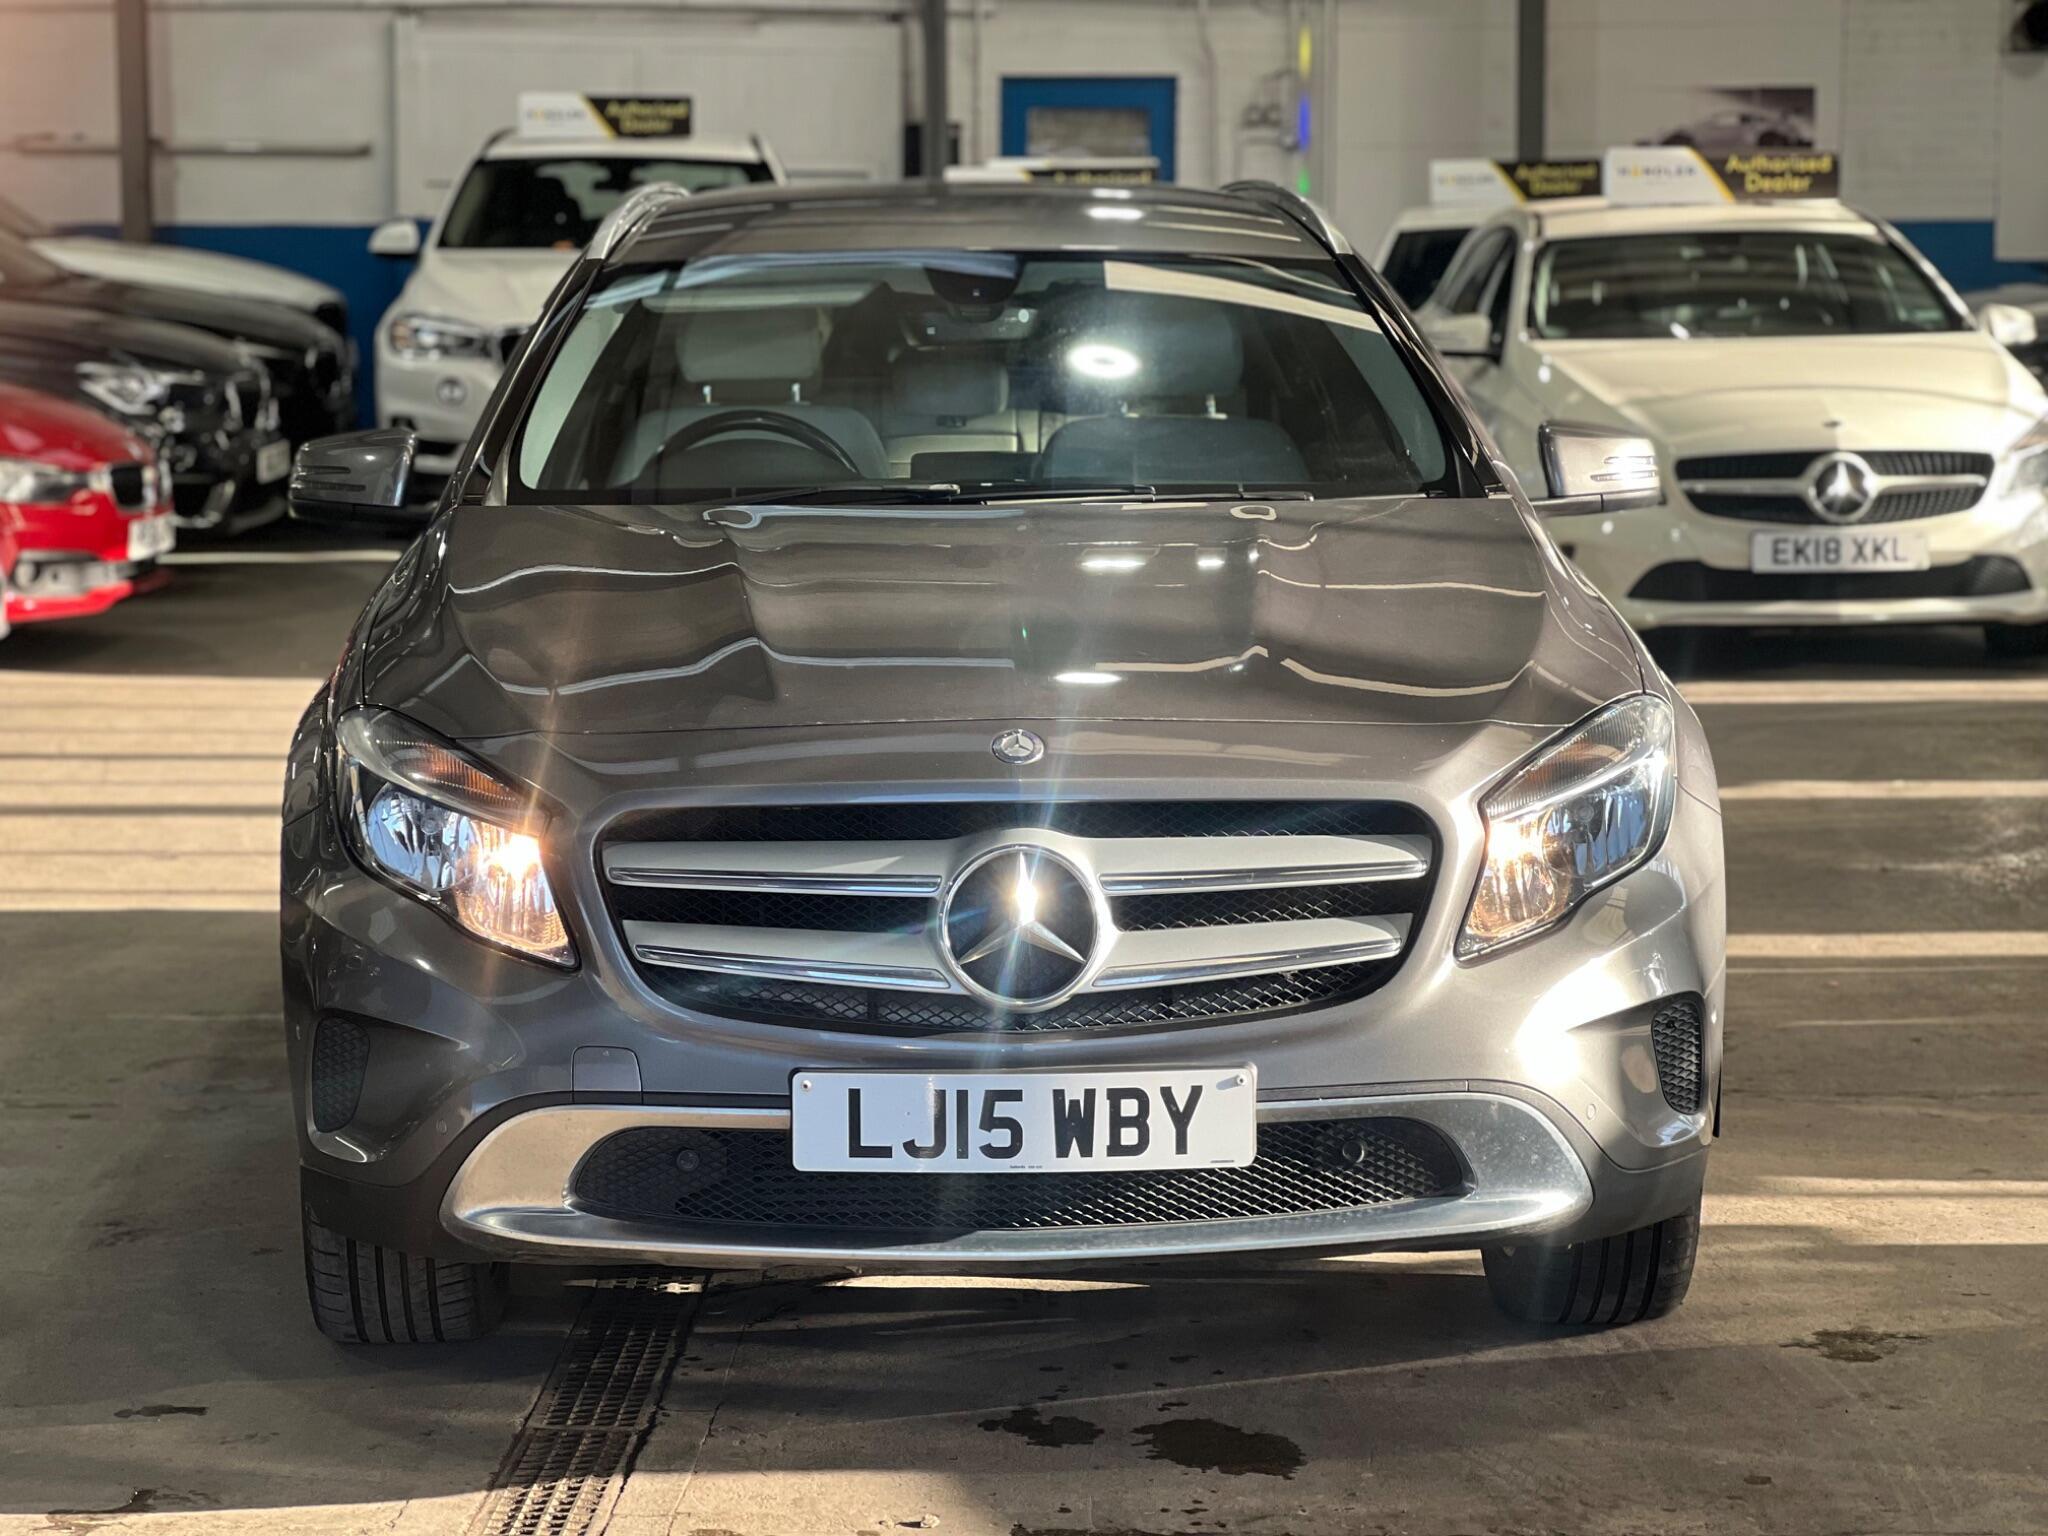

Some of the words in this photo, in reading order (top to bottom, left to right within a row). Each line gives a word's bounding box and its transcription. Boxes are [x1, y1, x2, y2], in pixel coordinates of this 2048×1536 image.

[1725, 153, 1833, 174] Authorised
[1745, 172, 1812, 193] Dealer
[1772, 537, 1841, 565] EK18
[1852, 537, 1908, 562] XKL
[848, 1088, 1023, 1159] LJ15
[1052, 1085, 1203, 1158] WBY
